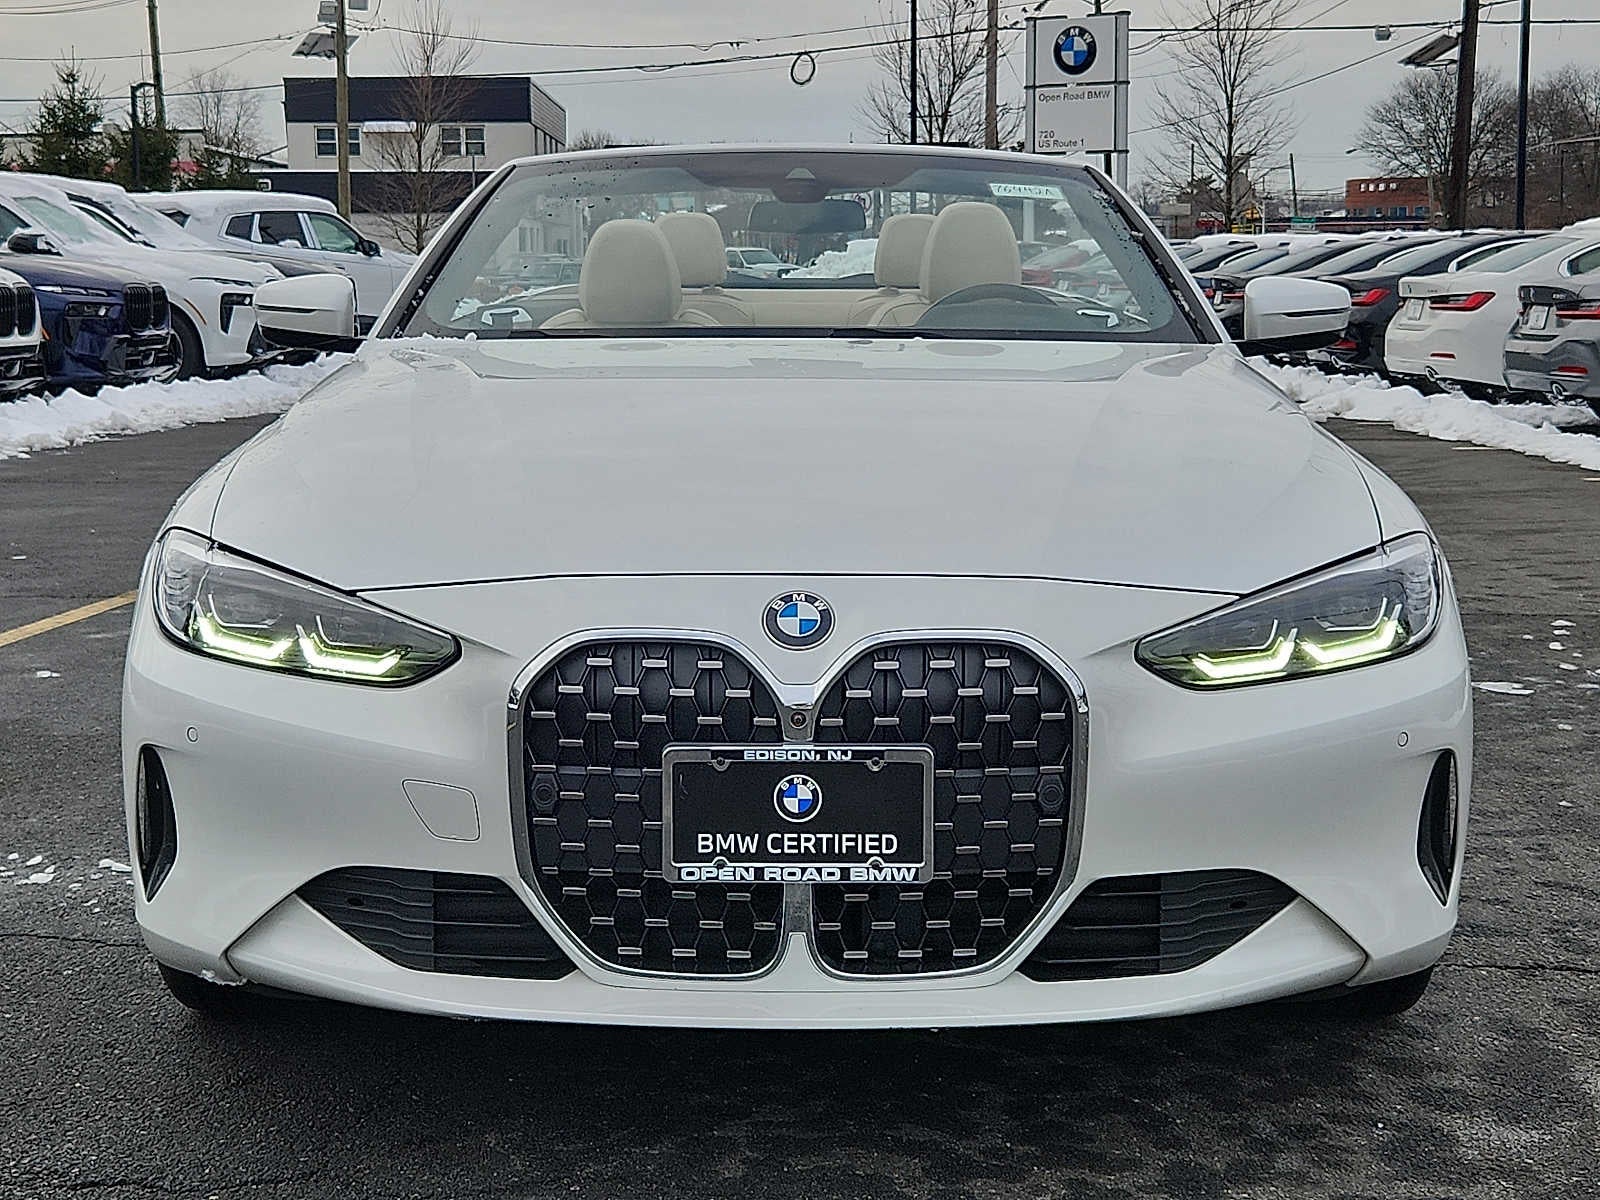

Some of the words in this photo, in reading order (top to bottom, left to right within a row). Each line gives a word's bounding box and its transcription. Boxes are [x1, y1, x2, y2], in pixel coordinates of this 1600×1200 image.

[1057, 27, 1093, 45] BMW
[1038, 93, 1061, 103] Open
[1063, 91, 1085, 101] Road
[1087, 90, 1111, 100] BMW
[1038, 130, 1055, 139] 720
[1038, 140, 1051, 148] US
[1053, 139, 1078, 148] Route
[771, 593, 828, 611] BMW
[743, 750, 821, 761] EDISON,
[827, 750, 852, 760] NJ
[780, 777, 816, 791] BMW
[697, 833, 759, 854] BMW
[766, 833, 898, 854] CERTIFIED
[680, 867, 755, 881] OPEN
[763, 867, 841, 881] ROAD
[850, 867, 917, 881] BMW
